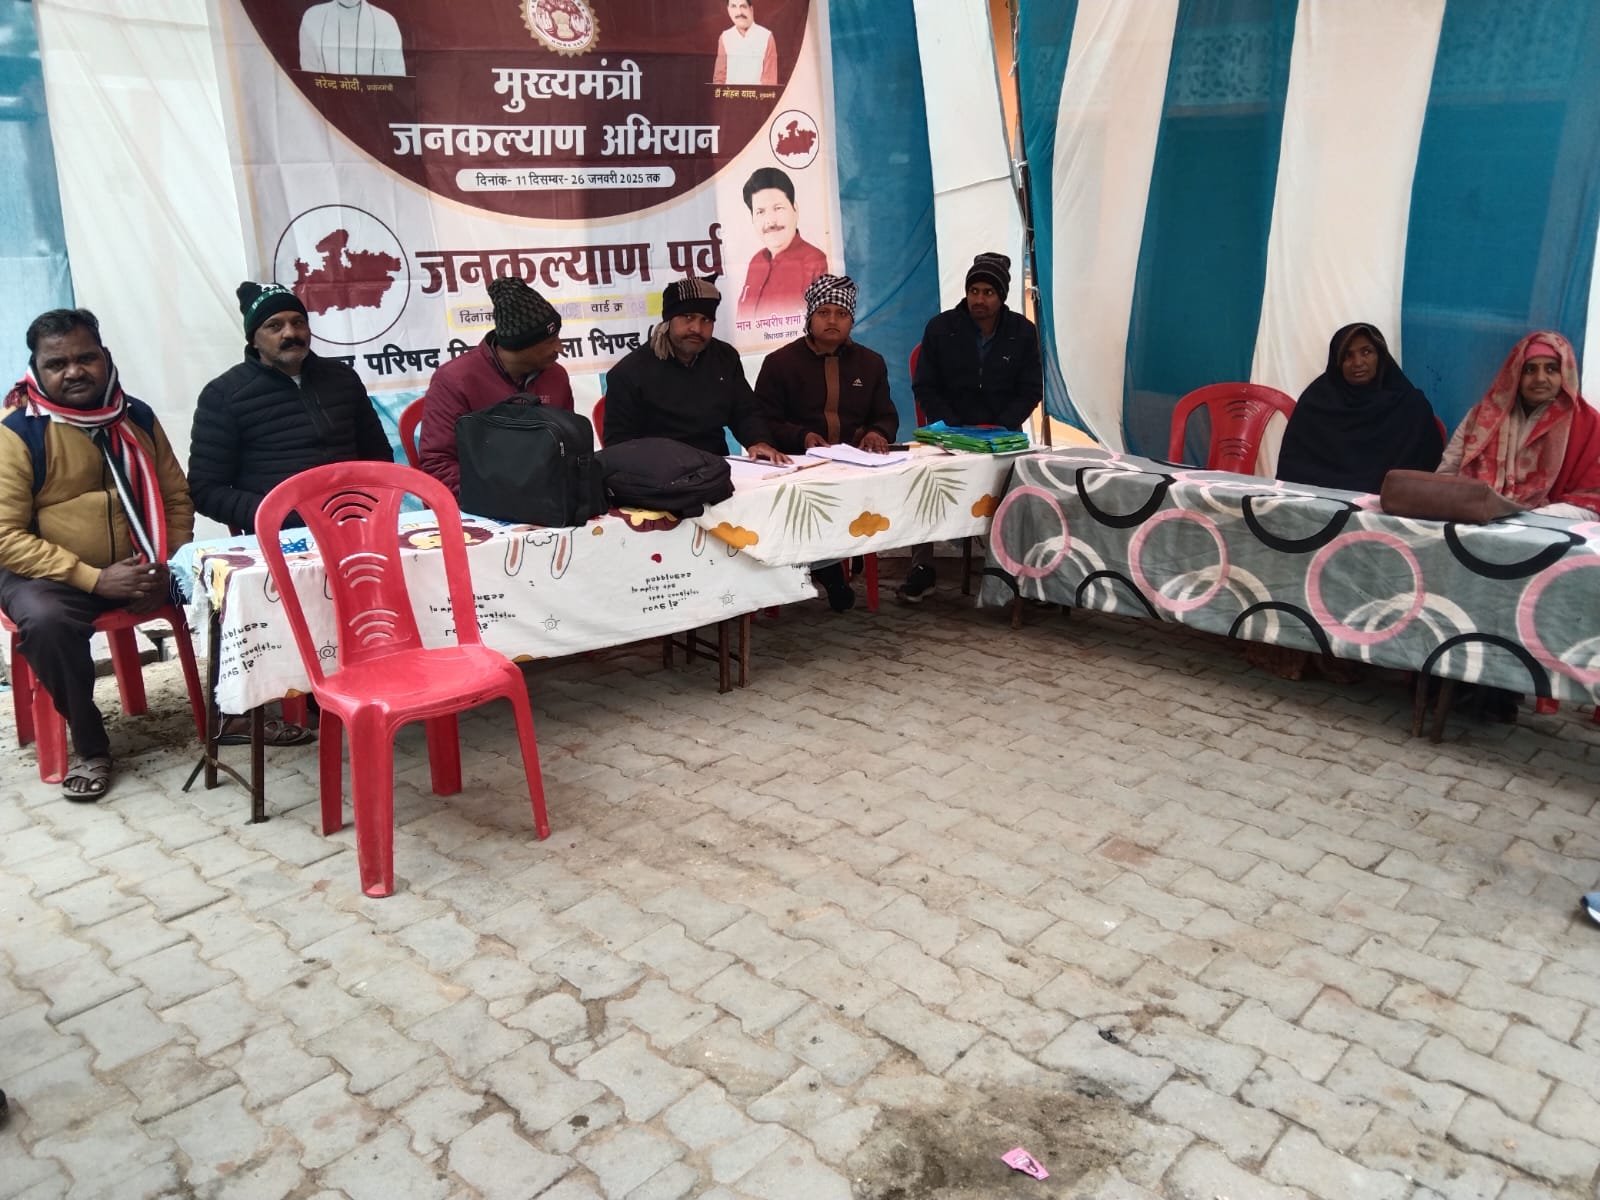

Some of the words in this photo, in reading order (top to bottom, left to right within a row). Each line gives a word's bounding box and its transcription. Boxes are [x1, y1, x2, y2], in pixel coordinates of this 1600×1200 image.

[491, 58, 643, 113] मुख्यमंत्री
[388, 123, 587, 157] जनकल्याण
[600, 113, 721, 157] अभियान
[517, 175, 527, 186] 11
[571, 174, 585, 185] 26
[587, 170, 618, 185] जनवरी
[620, 173, 644, 185] 2025
[645, 173, 661, 184] तक
[414, 242, 651, 294] जनकल्याण
[666, 222, 725, 277] पर्व
[590, 300, 610, 313] वार्ड
[363, 343, 441, 375] परिषद
[559, 337, 584, 358] ला
[587, 328, 641, 356] भिण्ड
